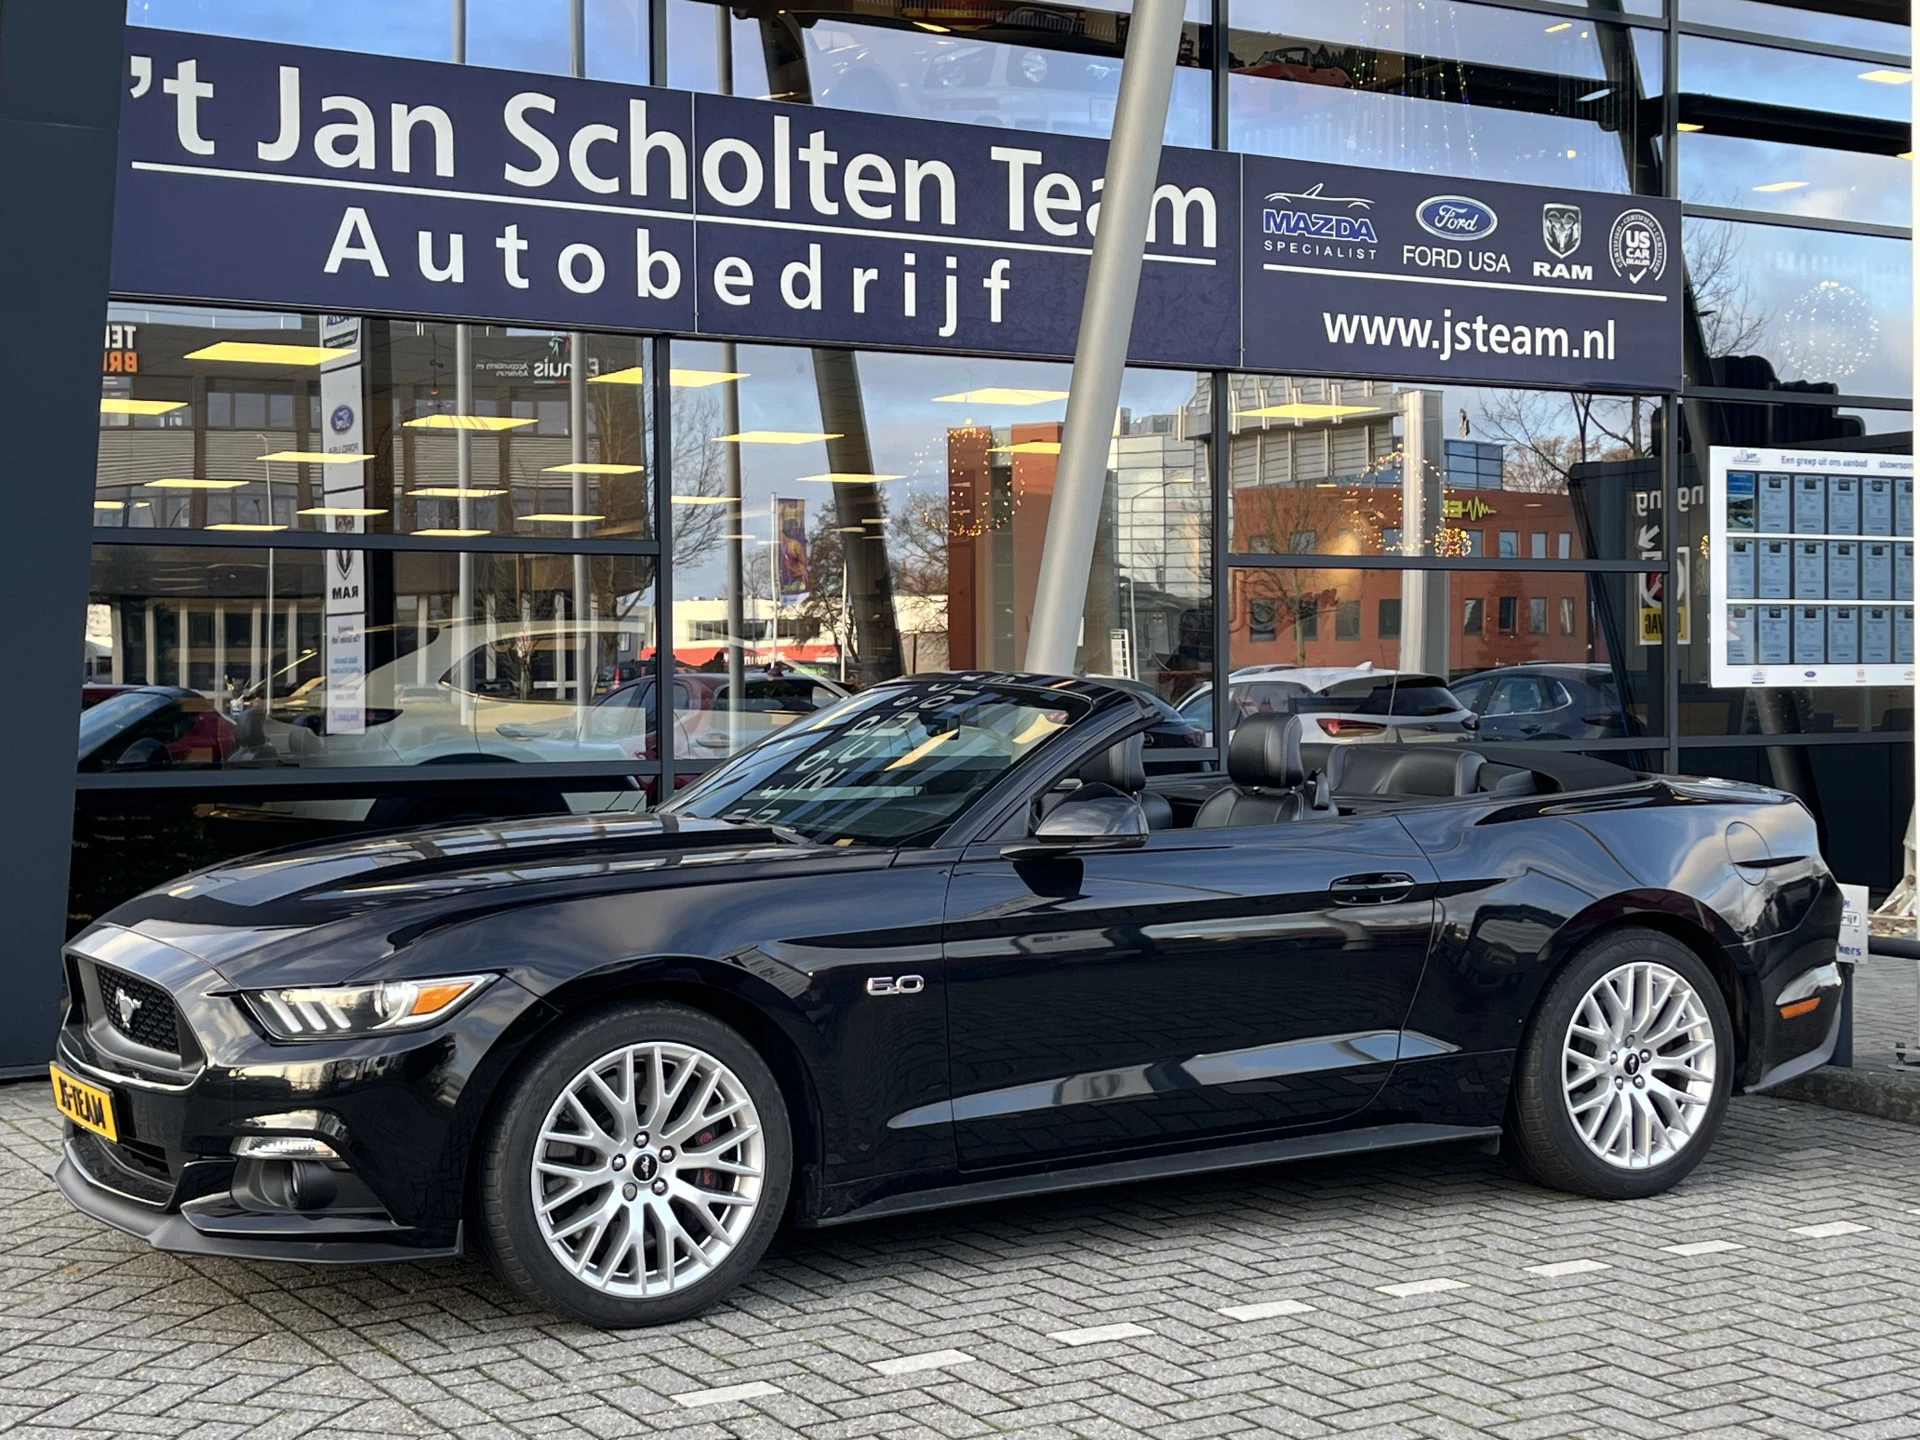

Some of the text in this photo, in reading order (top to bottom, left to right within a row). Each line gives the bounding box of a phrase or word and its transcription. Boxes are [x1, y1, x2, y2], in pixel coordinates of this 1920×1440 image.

[257, 65, 455, 177] Jan
[503, 92, 957, 225] Scholten
[1263, 208, 1378, 243] MAZDA
[1434, 204, 1479, 231] Ford
[1263, 240, 1377, 260] SPECIALIST
[1625, 229, 1651, 249] US
[1403, 244, 1511, 273] FORD USA
[1625, 247, 1650, 260] CAR
[1625, 257, 1650, 266] DEALER
[322, 206, 1011, 337] Autobedrijf
[1532, 261, 1593, 281] RAM
[1322, 308, 1615, 361] www.jsteam.nl
[867, 974, 925, 997] 5.0
